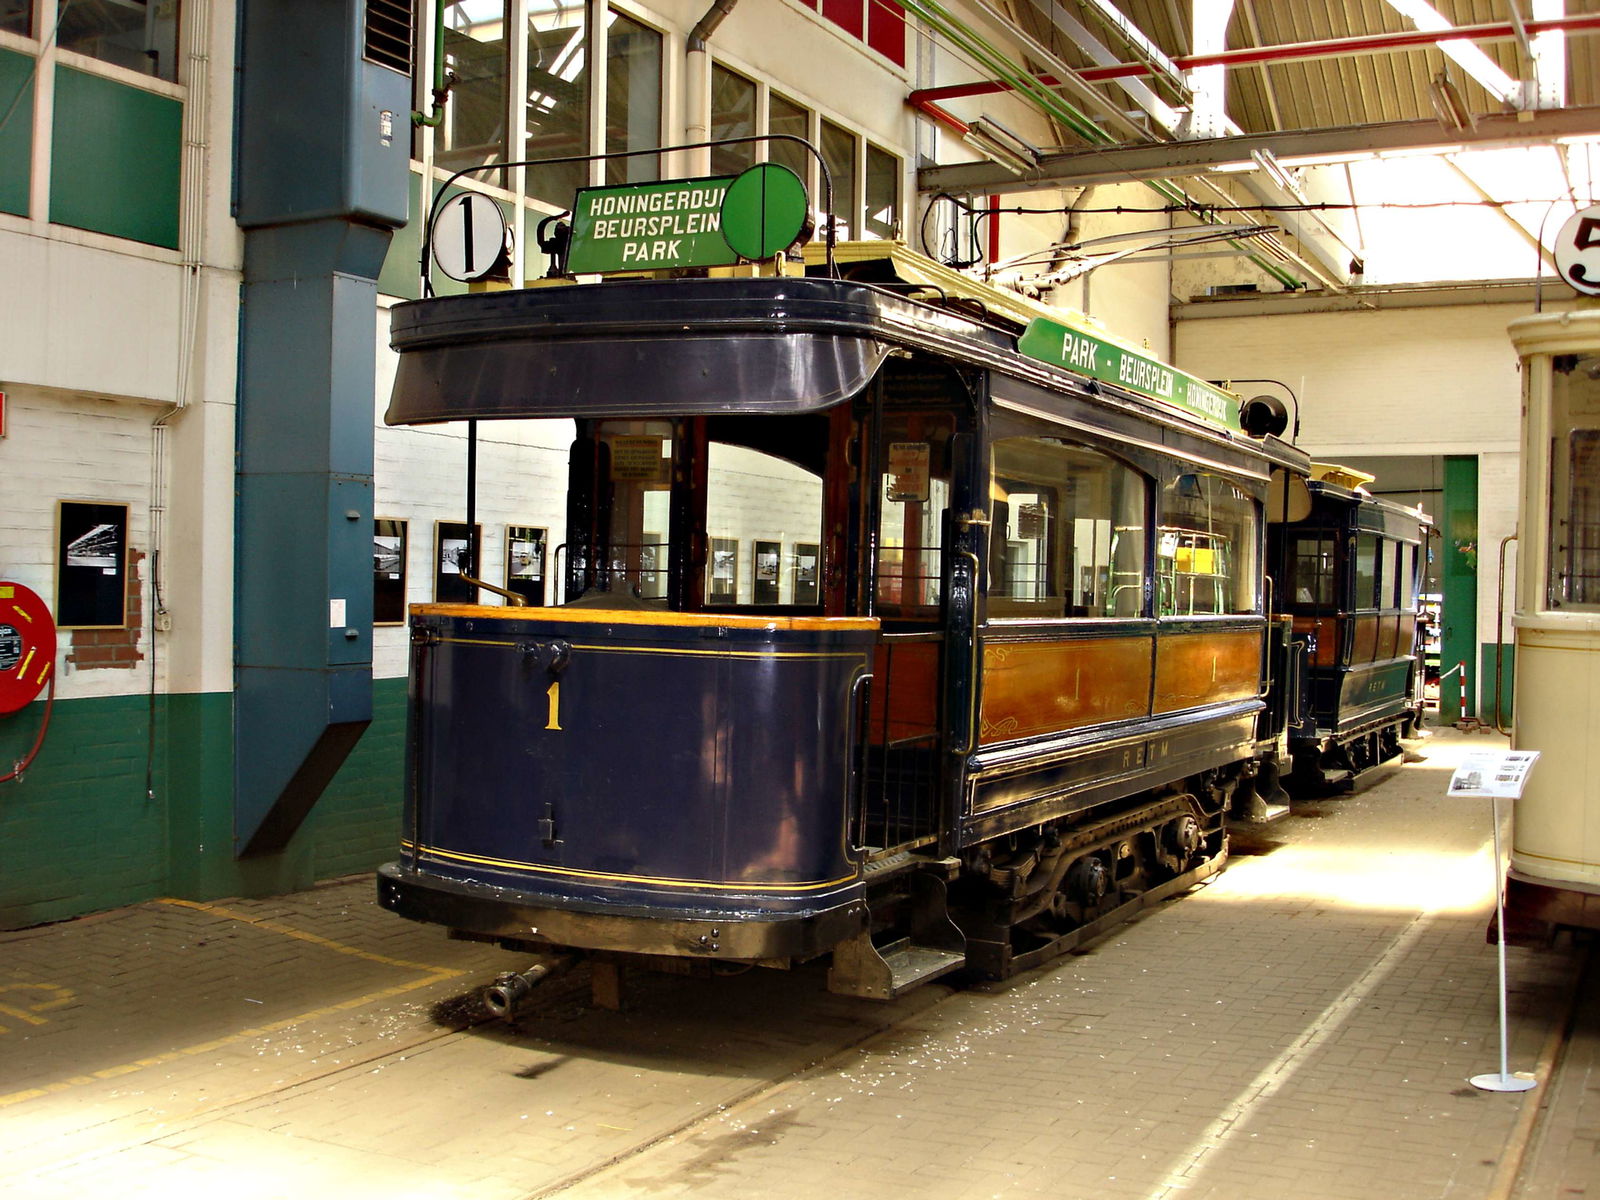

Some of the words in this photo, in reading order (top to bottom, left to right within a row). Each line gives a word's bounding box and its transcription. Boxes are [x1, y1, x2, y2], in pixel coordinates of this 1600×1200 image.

[458, 195, 476, 274] 1
[593, 212, 720, 240] BEURSPLEIN
[622, 240, 682, 262] PARK
[1062, 332, 1099, 372] PARK
[1119, 354, 1174, 398] BEURSPLEIN
[544, 681, 563, 731] 1
[1121, 740, 1169, 769] RETM
